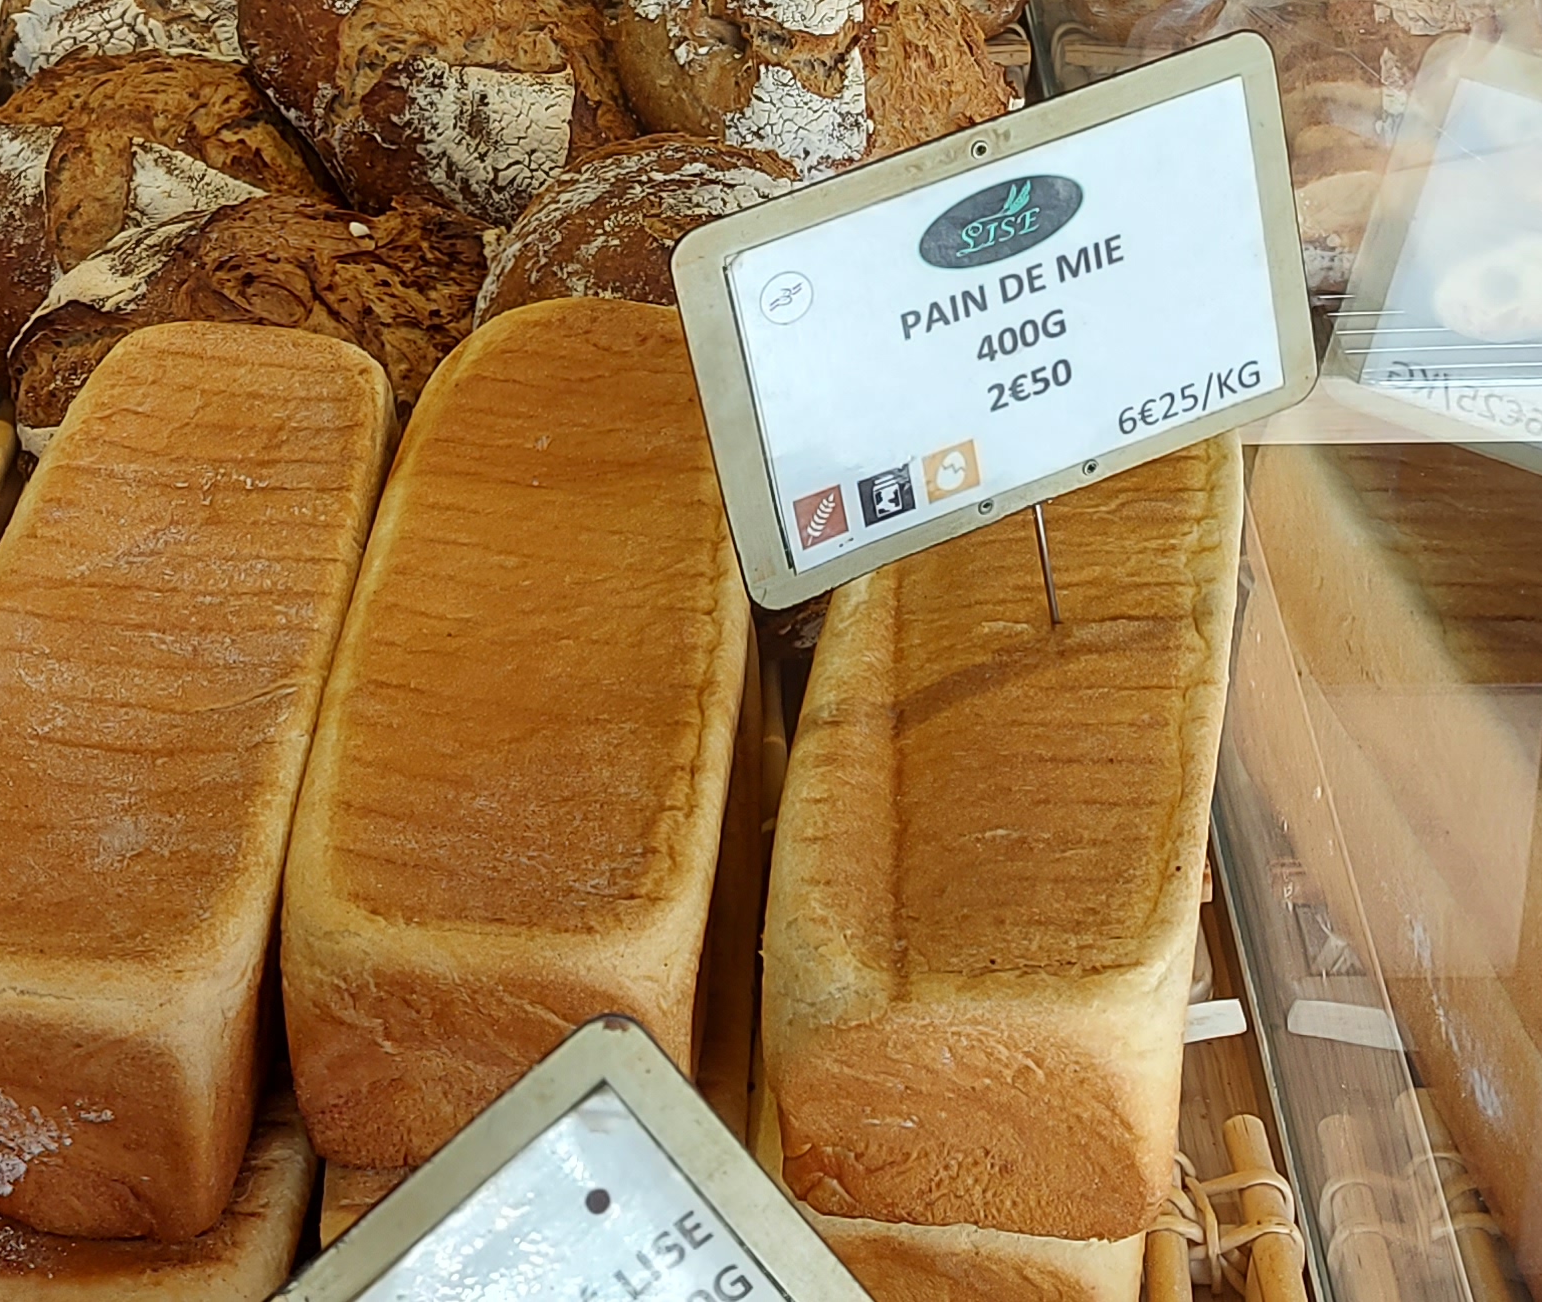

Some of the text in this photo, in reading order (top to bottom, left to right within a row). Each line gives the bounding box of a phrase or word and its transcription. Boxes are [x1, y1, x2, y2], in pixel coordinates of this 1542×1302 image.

[899, 234, 1126, 341] PAIN DE MIE
[976, 308, 1068, 363] 400G
[986, 359, 1073, 413] 2€50
[1117, 360, 1262, 437] 6€25/KG
[613, 1210, 715, 1300] LISE
